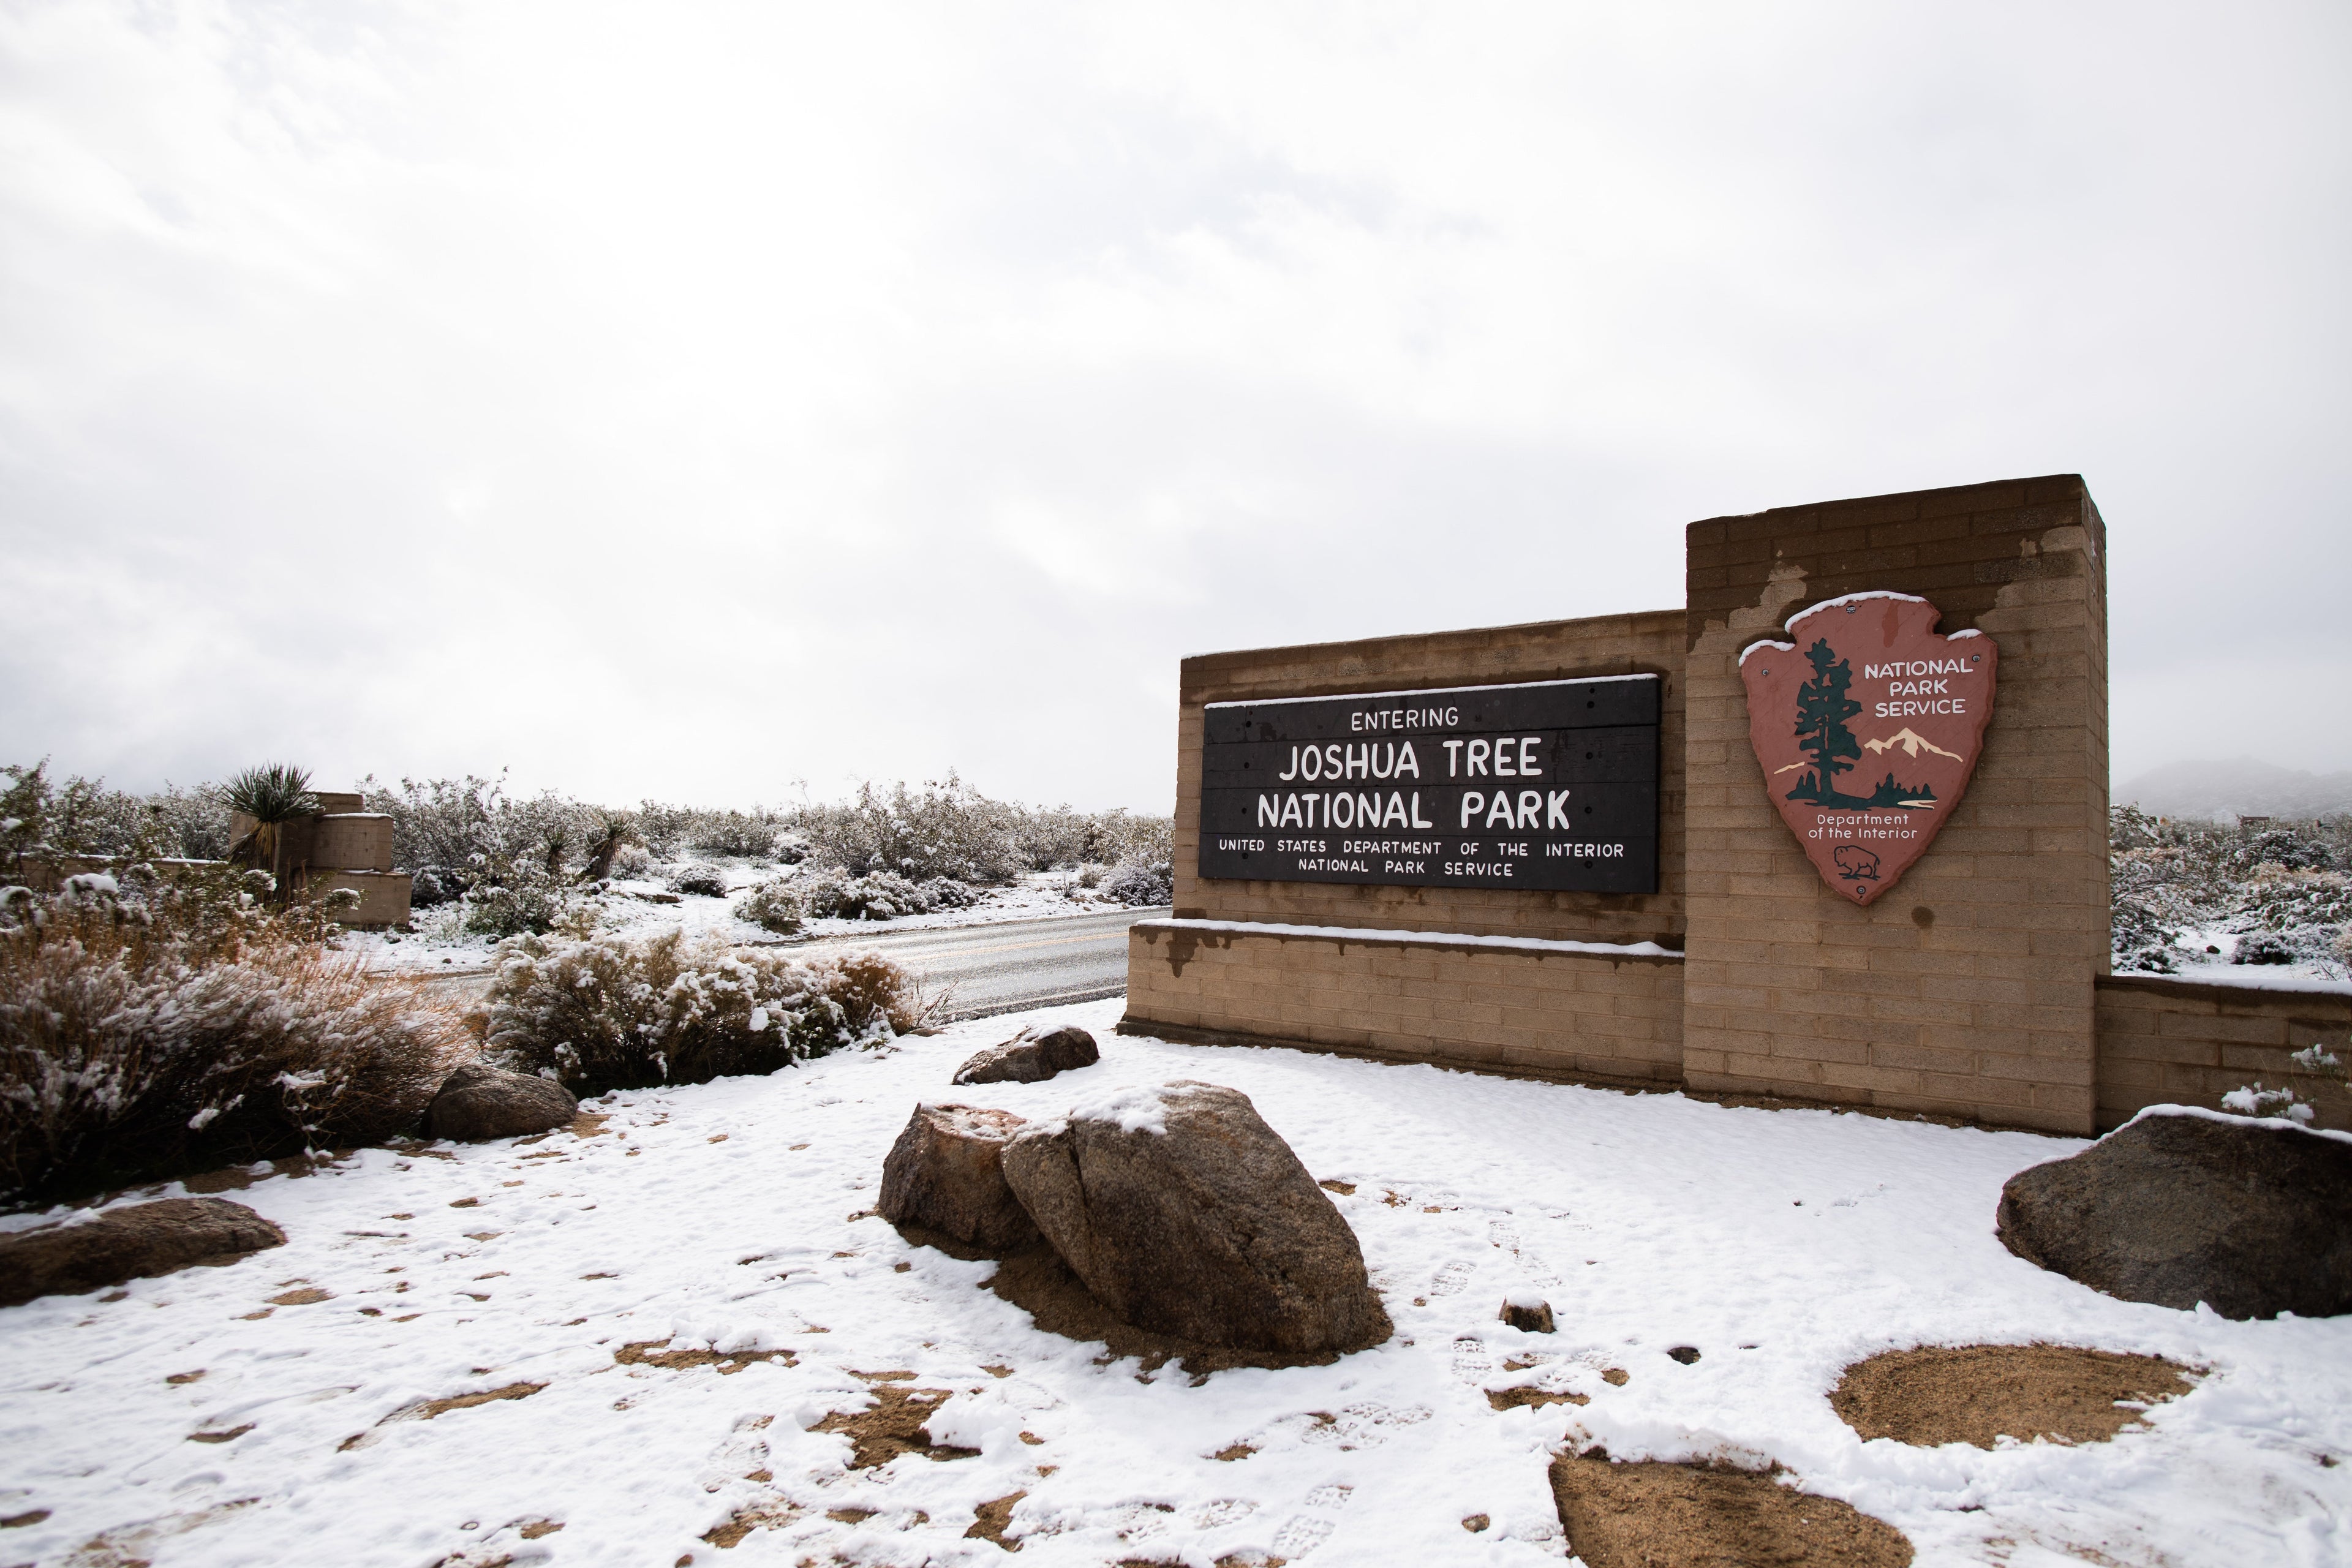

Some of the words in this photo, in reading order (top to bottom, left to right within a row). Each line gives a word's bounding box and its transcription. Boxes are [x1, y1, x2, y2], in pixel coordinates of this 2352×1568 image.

[1864, 658, 1973, 679] NATIONAL
[1890, 679, 1948, 697] PARK
[1875, 698, 1966, 718] SERVICE
[1351, 706, 1458, 731] ENTERING
[1279, 741, 1420, 781] JOSHUA
[1442, 737, 1542, 777] TREE
[1257, 791, 1433, 829] NATIONAL
[1461, 790, 1570, 830] PARK
[1817, 813, 1909, 827] Department
[1808, 827, 1823, 840] of
[1828, 827, 1852, 839] the
[1858, 827, 1918, 839] Interior
[1219, 839, 1265, 851] UNITED
[1277, 839, 1326, 853] STATES
[1343, 840, 1442, 854] DEPARTMENT
[1460, 842, 1479, 855] OF
[1497, 843, 1528, 856] THE
[1546, 843, 1624, 858] INTERIOR
[1298, 858, 1369, 872] NATIONAL
[1385, 860, 1425, 873] PARK
[1444, 862, 1513, 876] SERVICE
